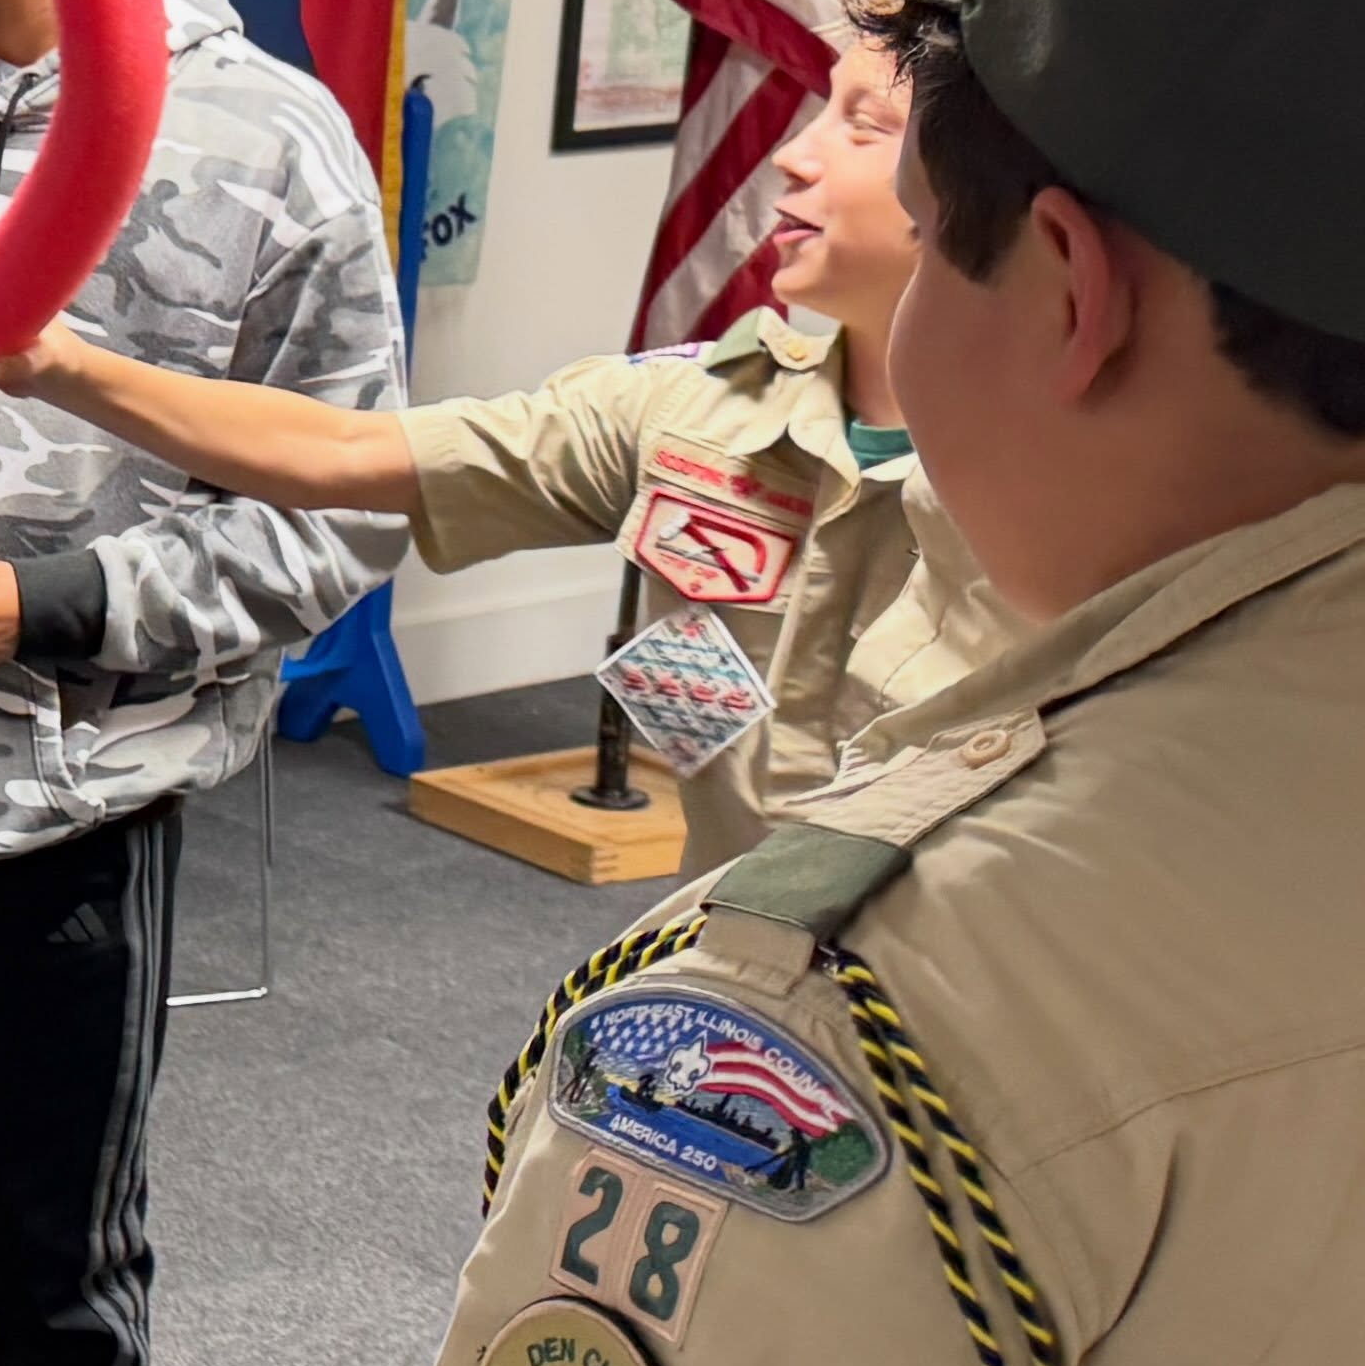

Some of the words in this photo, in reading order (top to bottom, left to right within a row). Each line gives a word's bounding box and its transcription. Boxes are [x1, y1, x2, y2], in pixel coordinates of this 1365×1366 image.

[603, 1003, 695, 1026] NORTHEAST
[695, 1010, 765, 1052] ILLINOIS
[609, 1113, 678, 1154] AMERICA
[680, 1145, 717, 1172] 250
[561, 1166, 700, 1321] 28
